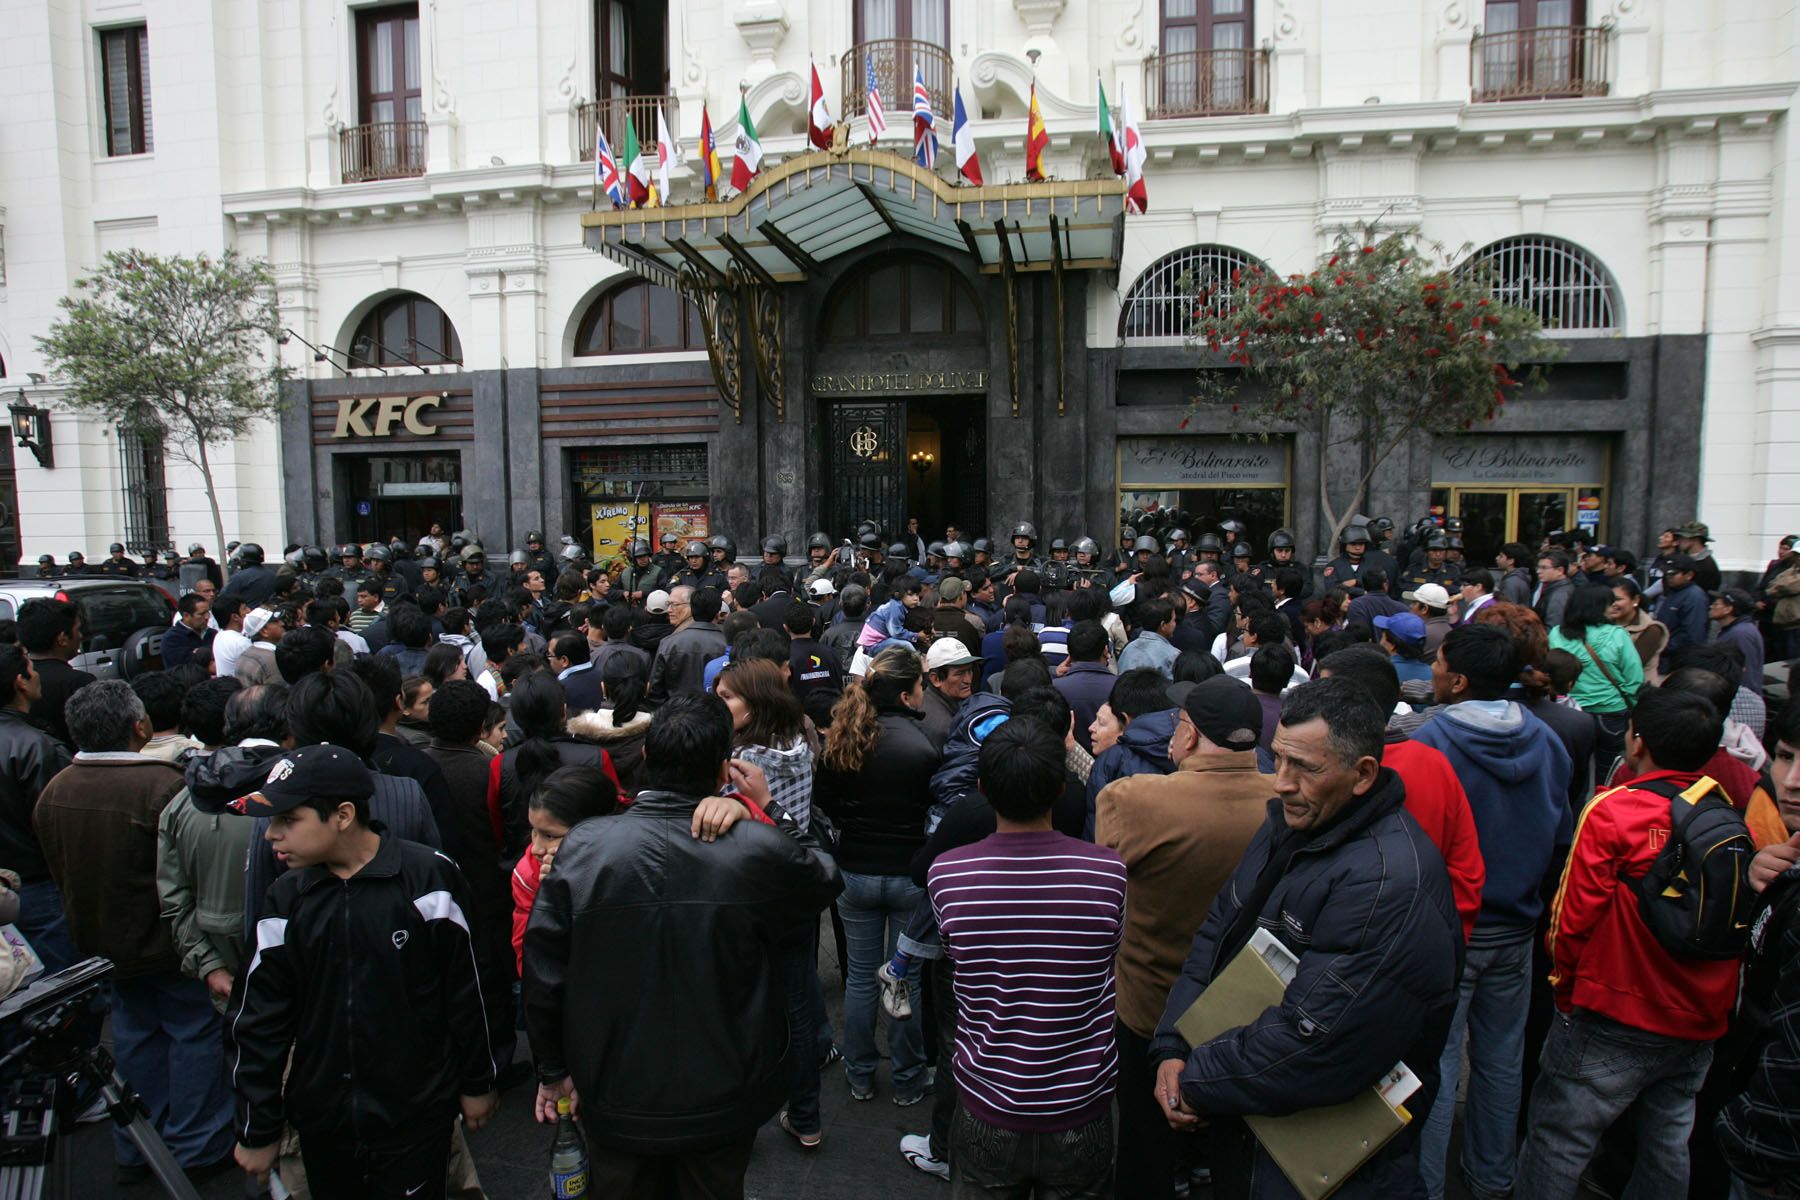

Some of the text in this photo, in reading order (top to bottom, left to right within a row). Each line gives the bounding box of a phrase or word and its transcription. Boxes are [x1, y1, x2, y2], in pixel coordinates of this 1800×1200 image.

[811, 371, 990, 392] GRAN HOTEL BOLIVAR
[332, 396, 440, 438] KFC
[1171, 448, 1269, 469] Bolivarcito
[1440, 447, 1586, 470] El Bolivarcito
[596, 507, 628, 520] XTREMO
